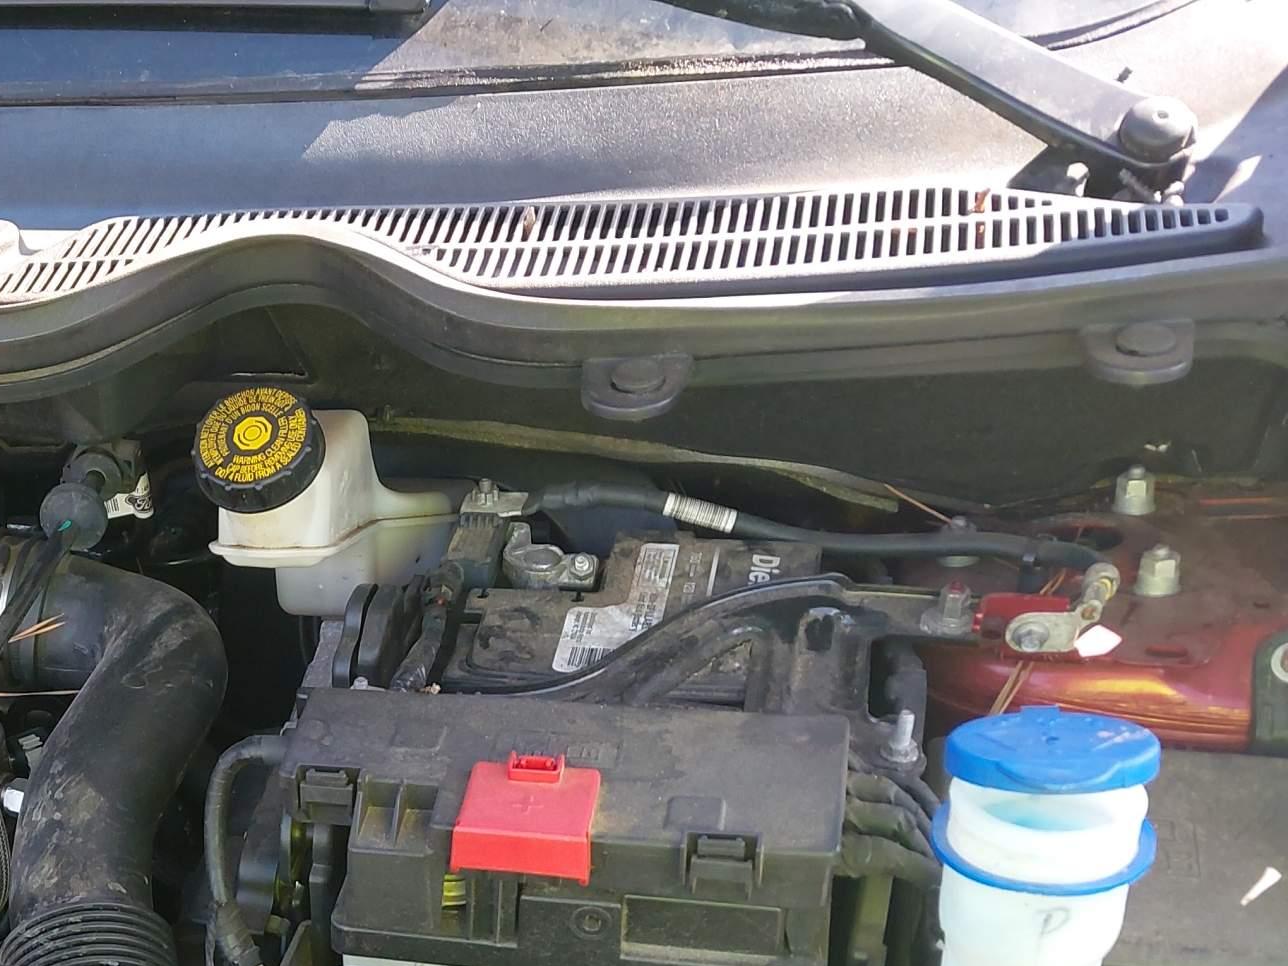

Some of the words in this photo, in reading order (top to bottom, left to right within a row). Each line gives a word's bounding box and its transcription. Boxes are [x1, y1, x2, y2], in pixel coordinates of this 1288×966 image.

[233, 451, 266, 466] WARNING
[265, 439, 285, 457] CLEAN
[215, 466, 229, 479] DOT
[233, 472, 254, 482] FLUID
[255, 466, 276, 480] FROM
[226, 463, 241, 474] CAP
